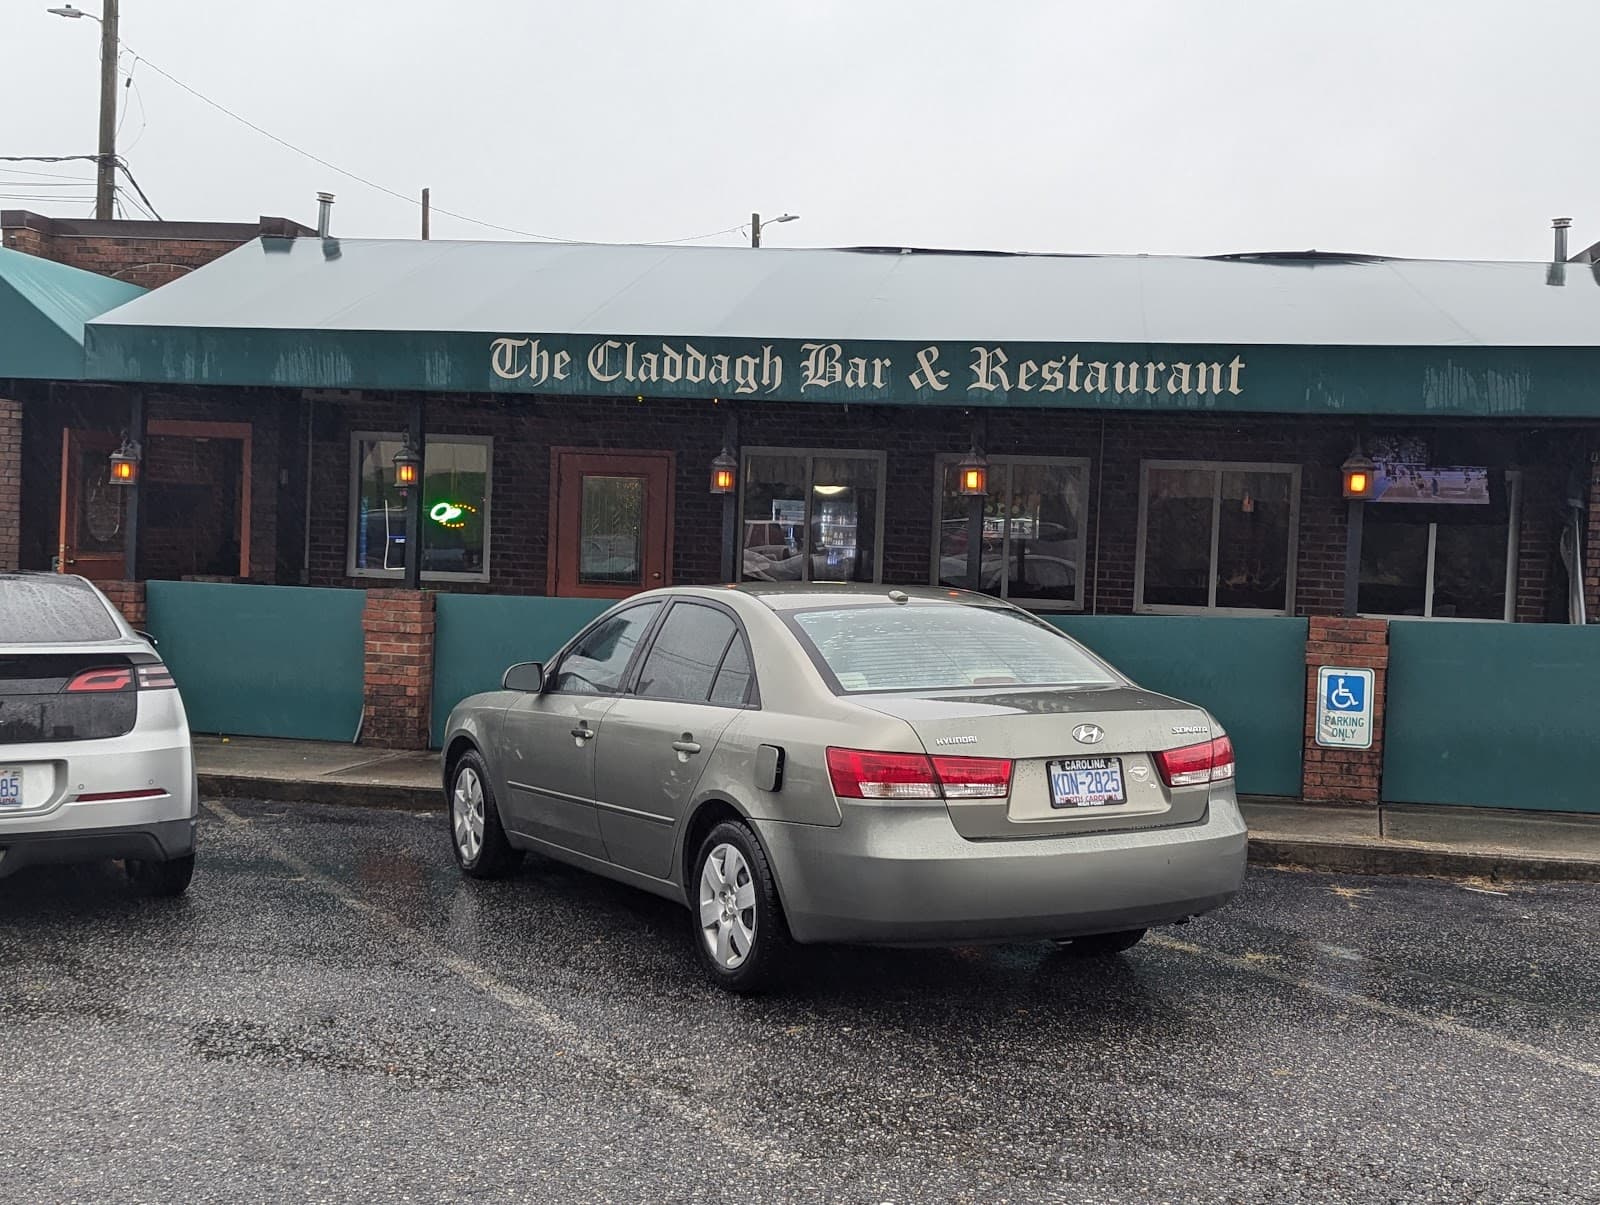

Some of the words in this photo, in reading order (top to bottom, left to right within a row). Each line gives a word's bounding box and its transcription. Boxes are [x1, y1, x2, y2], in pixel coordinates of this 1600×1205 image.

[489, 338, 570, 387] The
[587, 339, 783, 394] Claddagh
[800, 343, 891, 392] Bar
[908, 346, 950, 391] &
[966, 347, 1246, 395] Restaurant
[1324, 715, 1364, 727] PARKING
[1331, 727, 1356, 738] ONLY
[936, 735, 977, 745] HYUNDAI
[1065, 759, 1106, 769] CAROLINA
[1052, 771, 1120, 795] KDN-2825
